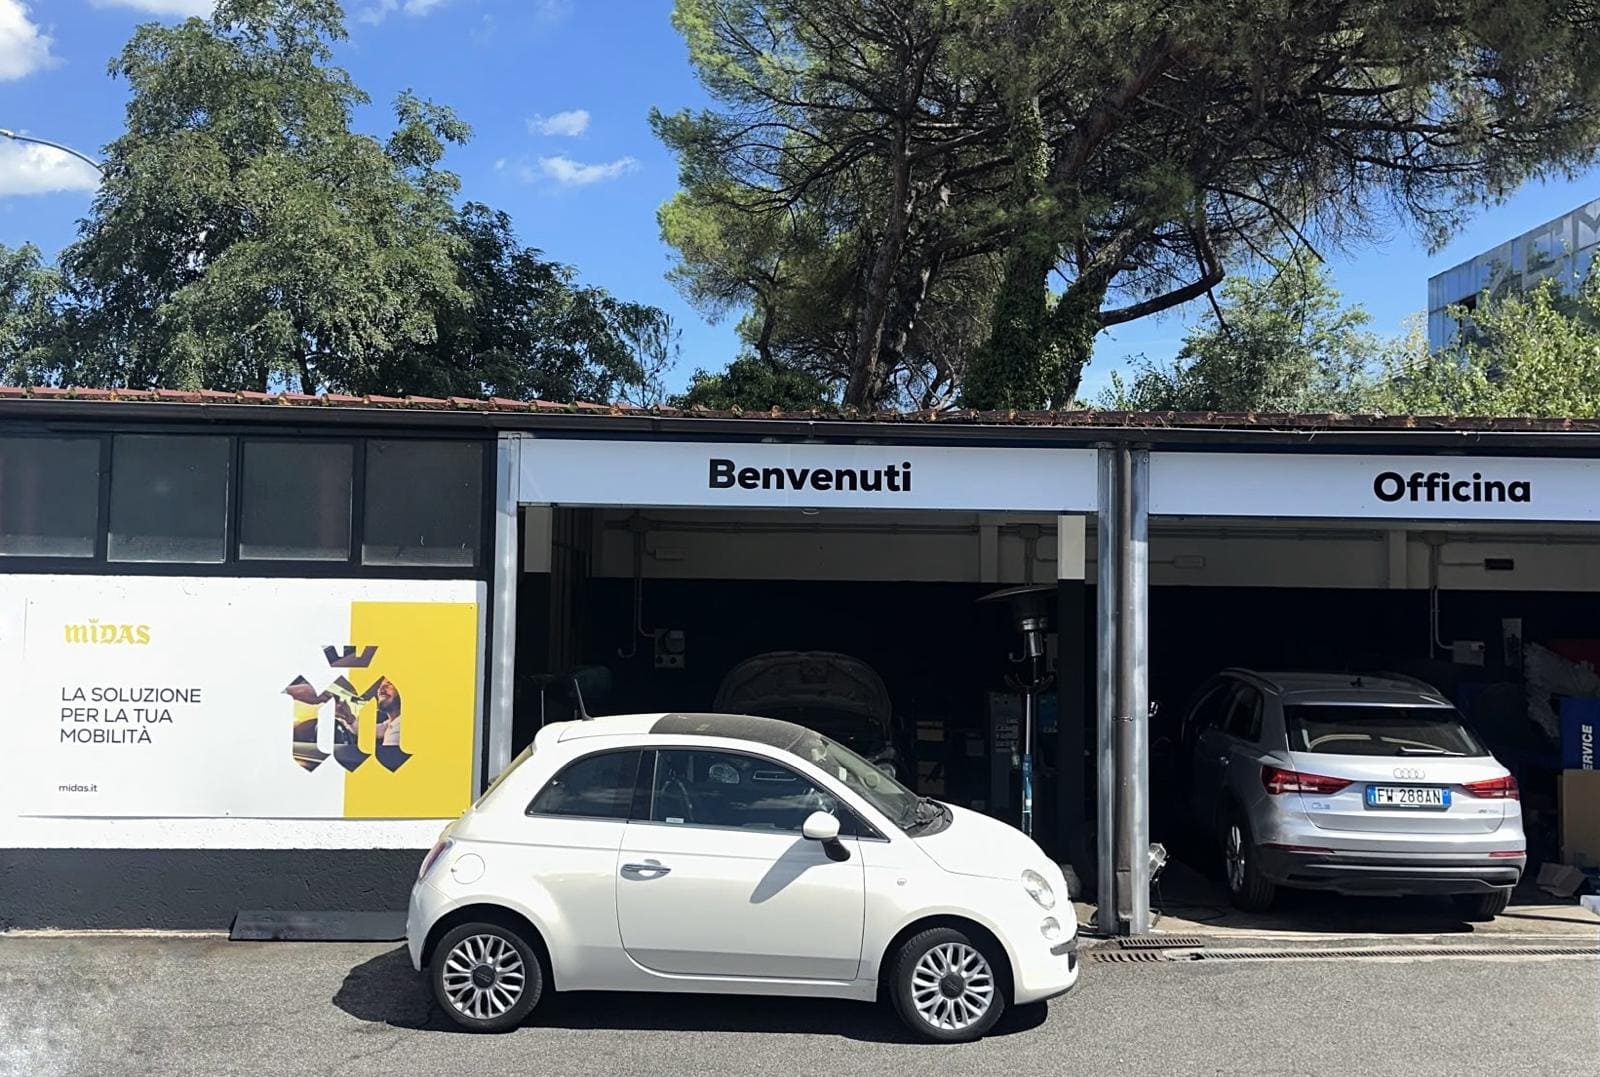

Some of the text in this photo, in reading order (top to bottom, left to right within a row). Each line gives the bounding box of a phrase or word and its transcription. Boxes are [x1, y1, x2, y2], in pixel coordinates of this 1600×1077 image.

[708, 458, 912, 492] Benvenuti
[1373, 471, 1531, 503] Officina
[61, 687, 201, 703] LA SOLUZIONE
[61, 707, 173, 724] PER LA TUA
[60, 725, 152, 744] MOBILITÀ
[58, 783, 98, 793] midas.it
[1377, 788, 1441, 804] FW 288AN
